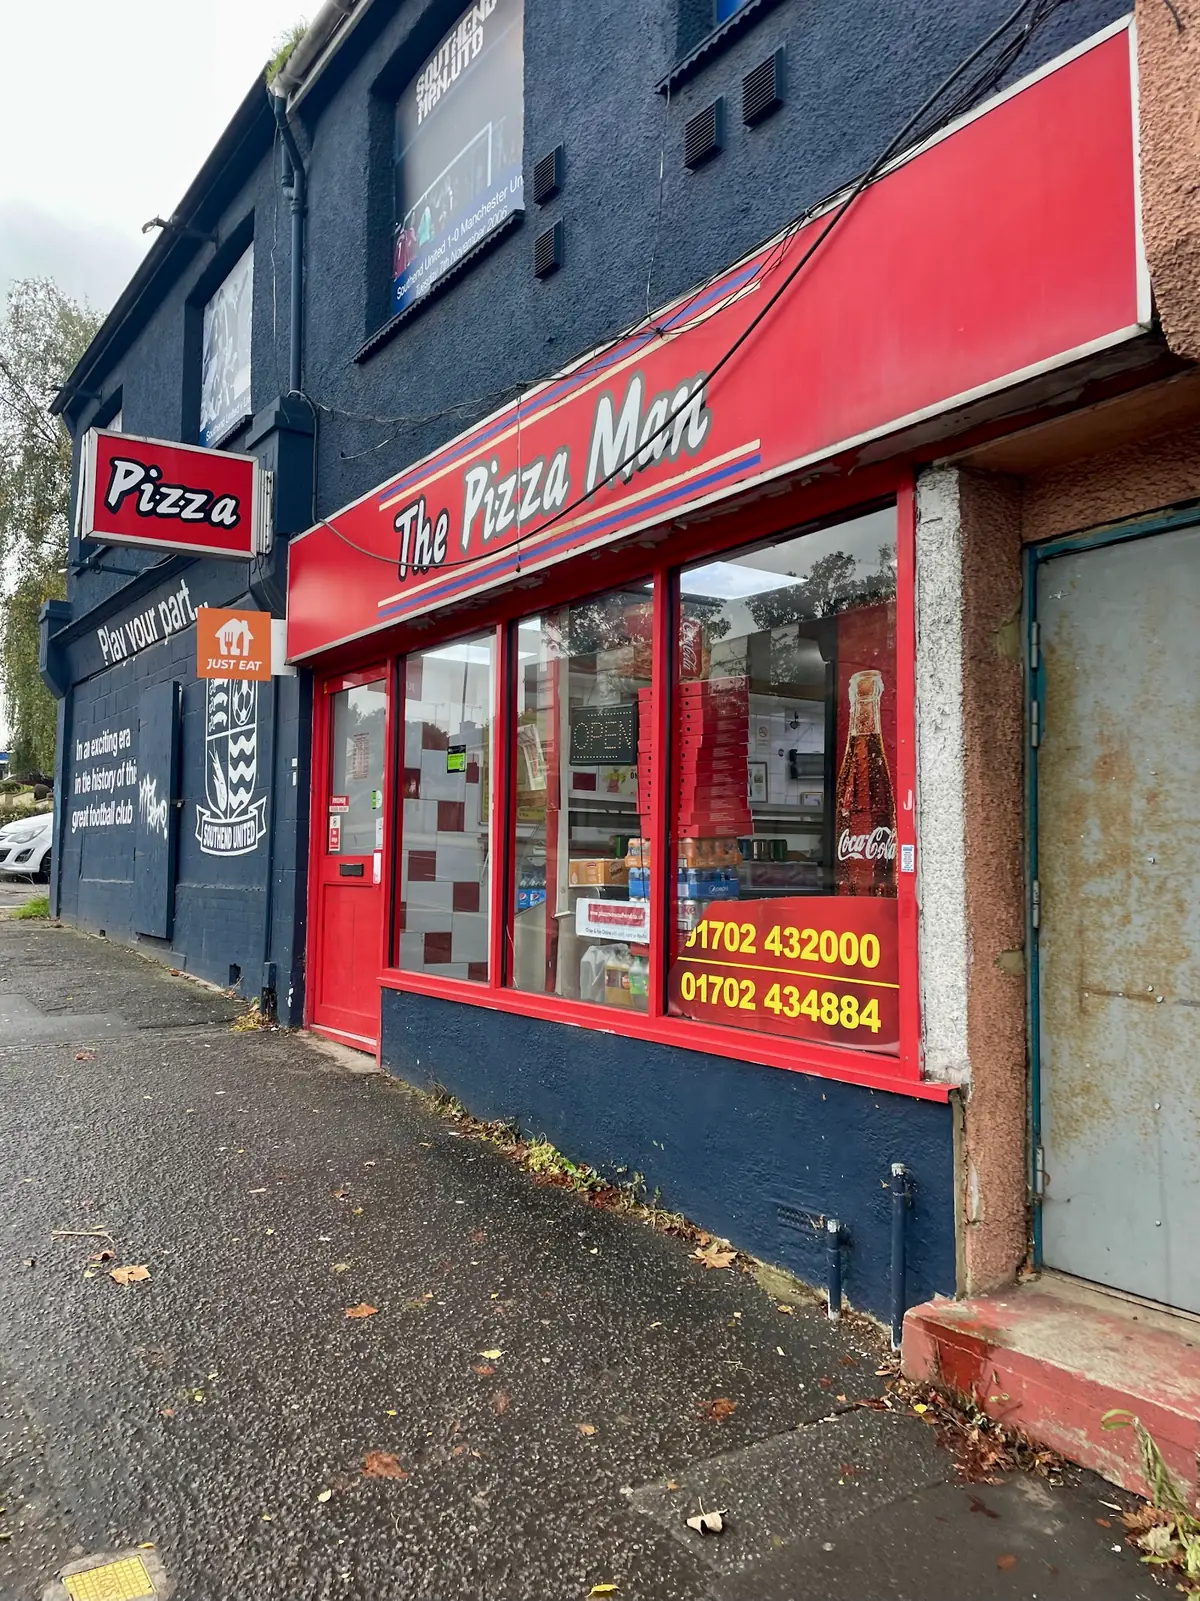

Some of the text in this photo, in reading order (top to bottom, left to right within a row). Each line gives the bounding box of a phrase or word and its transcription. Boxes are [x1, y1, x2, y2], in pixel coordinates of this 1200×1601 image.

[416, 0, 497, 103] SOUTHEND
[486, 204, 510, 231] 2006
[396, 259, 425, 300] Southend
[424, 239, 446, 264] United
[460, 185, 509, 238] Manchester
[107, 458, 238, 526] Pizza
[394, 373, 711, 579] The Pizza Man
[124, 606, 159, 662] your
[206, 658, 263, 671] JUST EAT
[118, 728, 131, 749] era
[573, 719, 633, 750] OPEN
[74, 772, 82, 794] in
[91, 767, 117, 794] history
[117, 761, 126, 787] of
[115, 798, 133, 825] club
[203, 820, 256, 850] SOUTHEND UNITED
[764, 925, 880, 969] 432000
[681, 971, 882, 1034] 01702 434884
